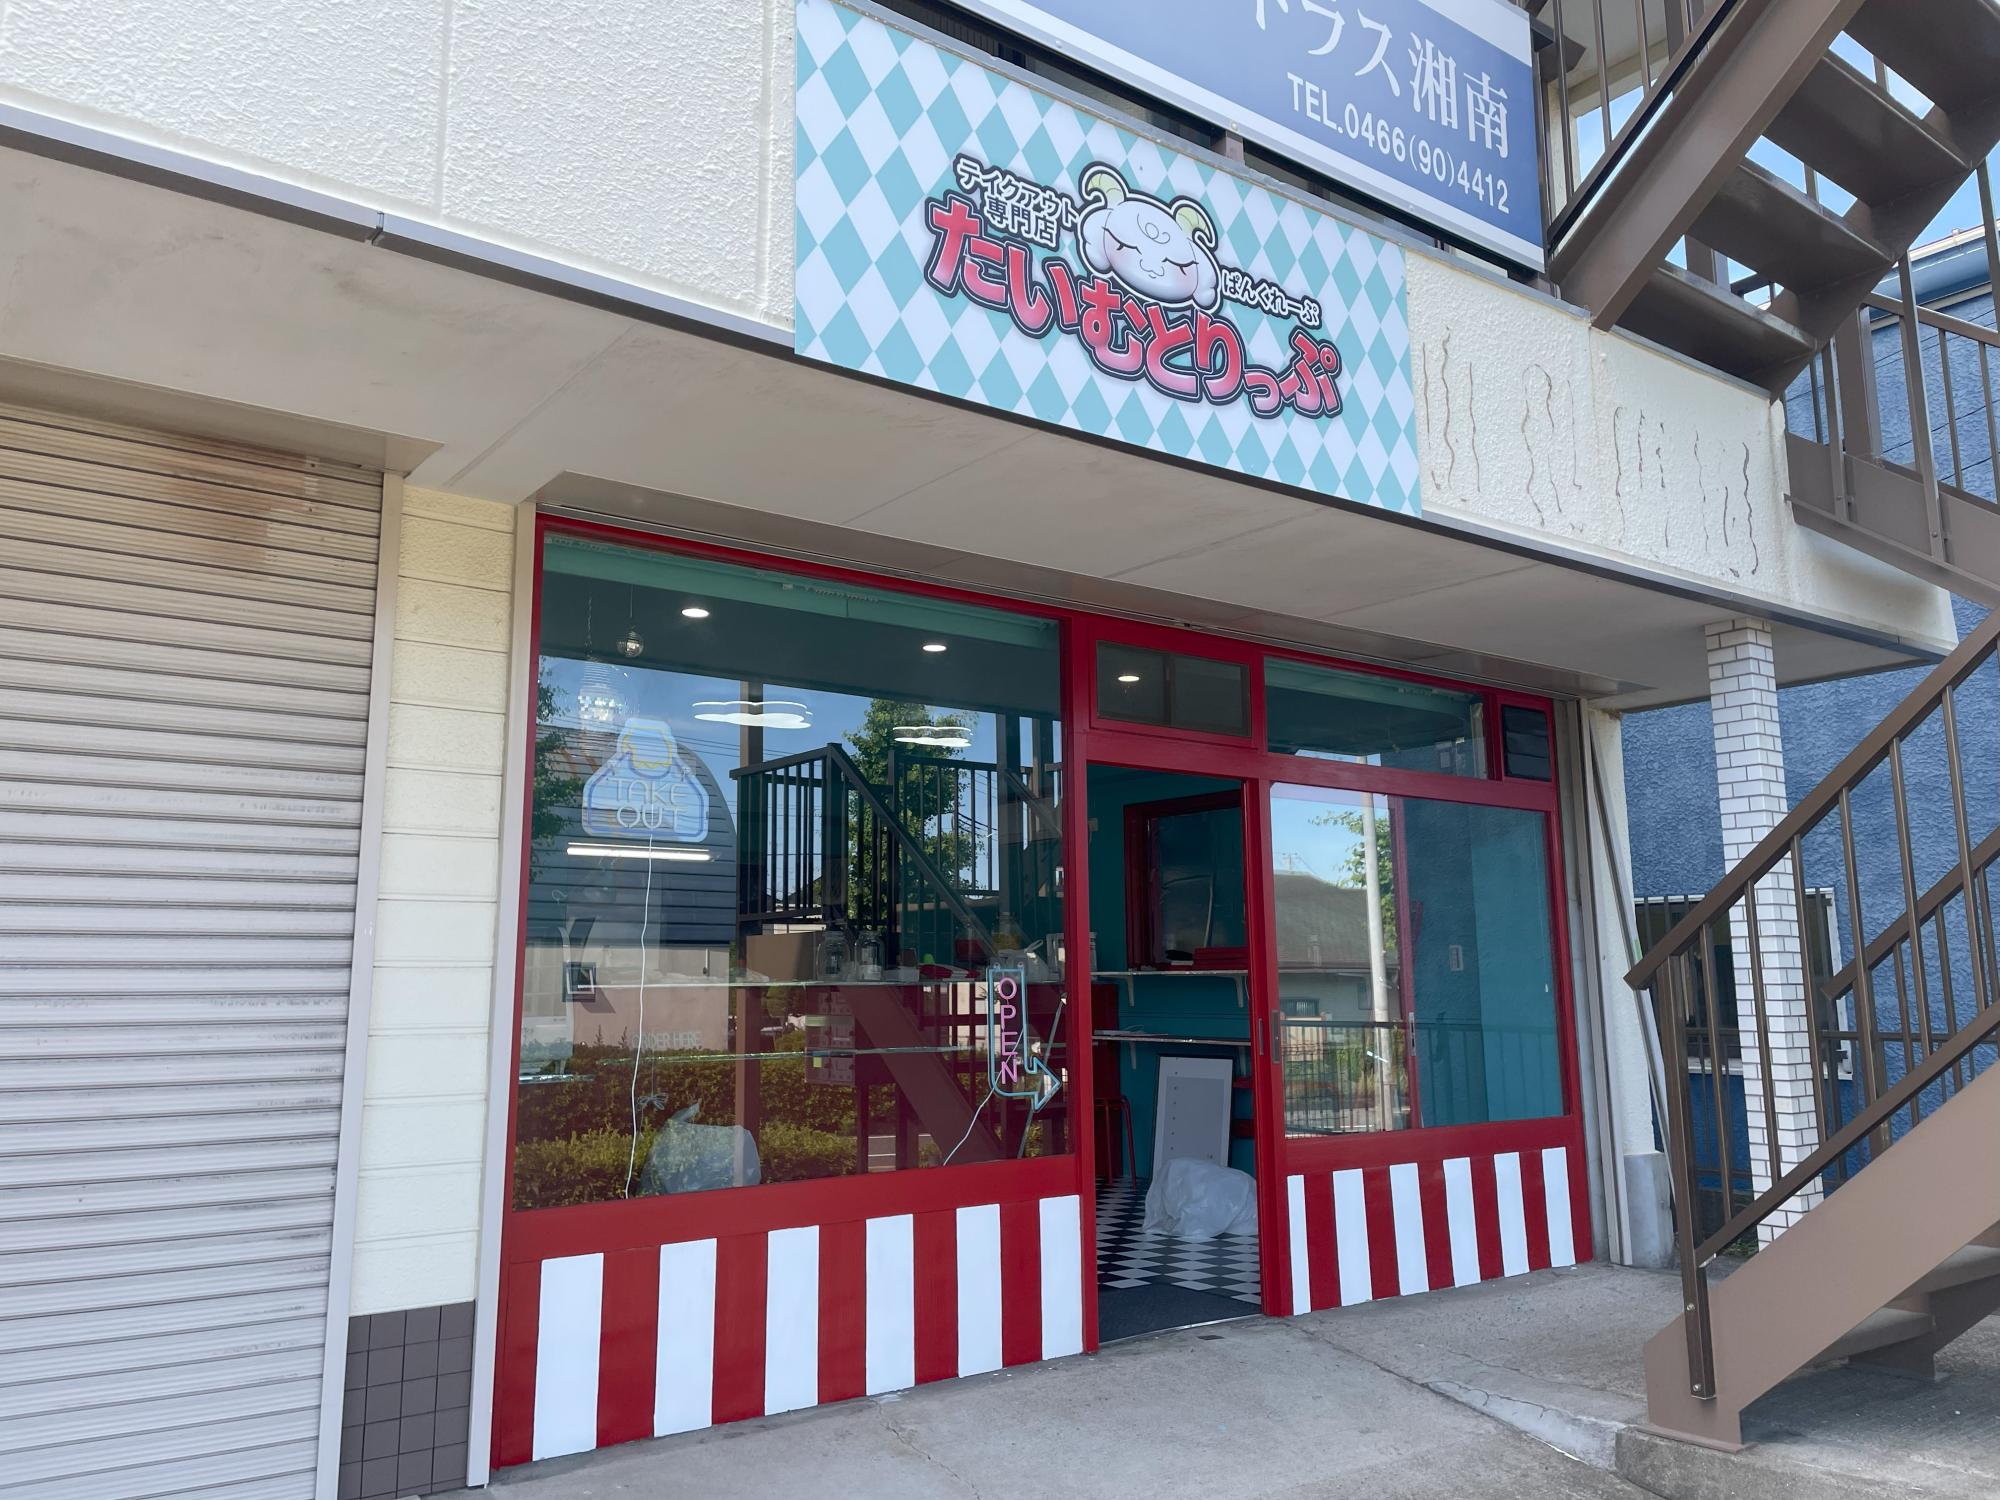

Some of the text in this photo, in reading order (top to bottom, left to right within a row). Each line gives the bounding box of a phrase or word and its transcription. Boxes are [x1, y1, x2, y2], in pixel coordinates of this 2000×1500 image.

[1287, 72, 1509, 214] TEL.0466(90)4412
[955, 156, 1080, 230] テイクアウト
[984, 194, 1059, 248] 専門店
[929, 196, 1341, 415] たいむとりっぷ
[1220, 267, 1321, 327] ぱんくれーぷ
[609, 778, 690, 806] TAKE
[616, 804, 688, 831] OUT
[999, 977, 1018, 1084] OPEN
